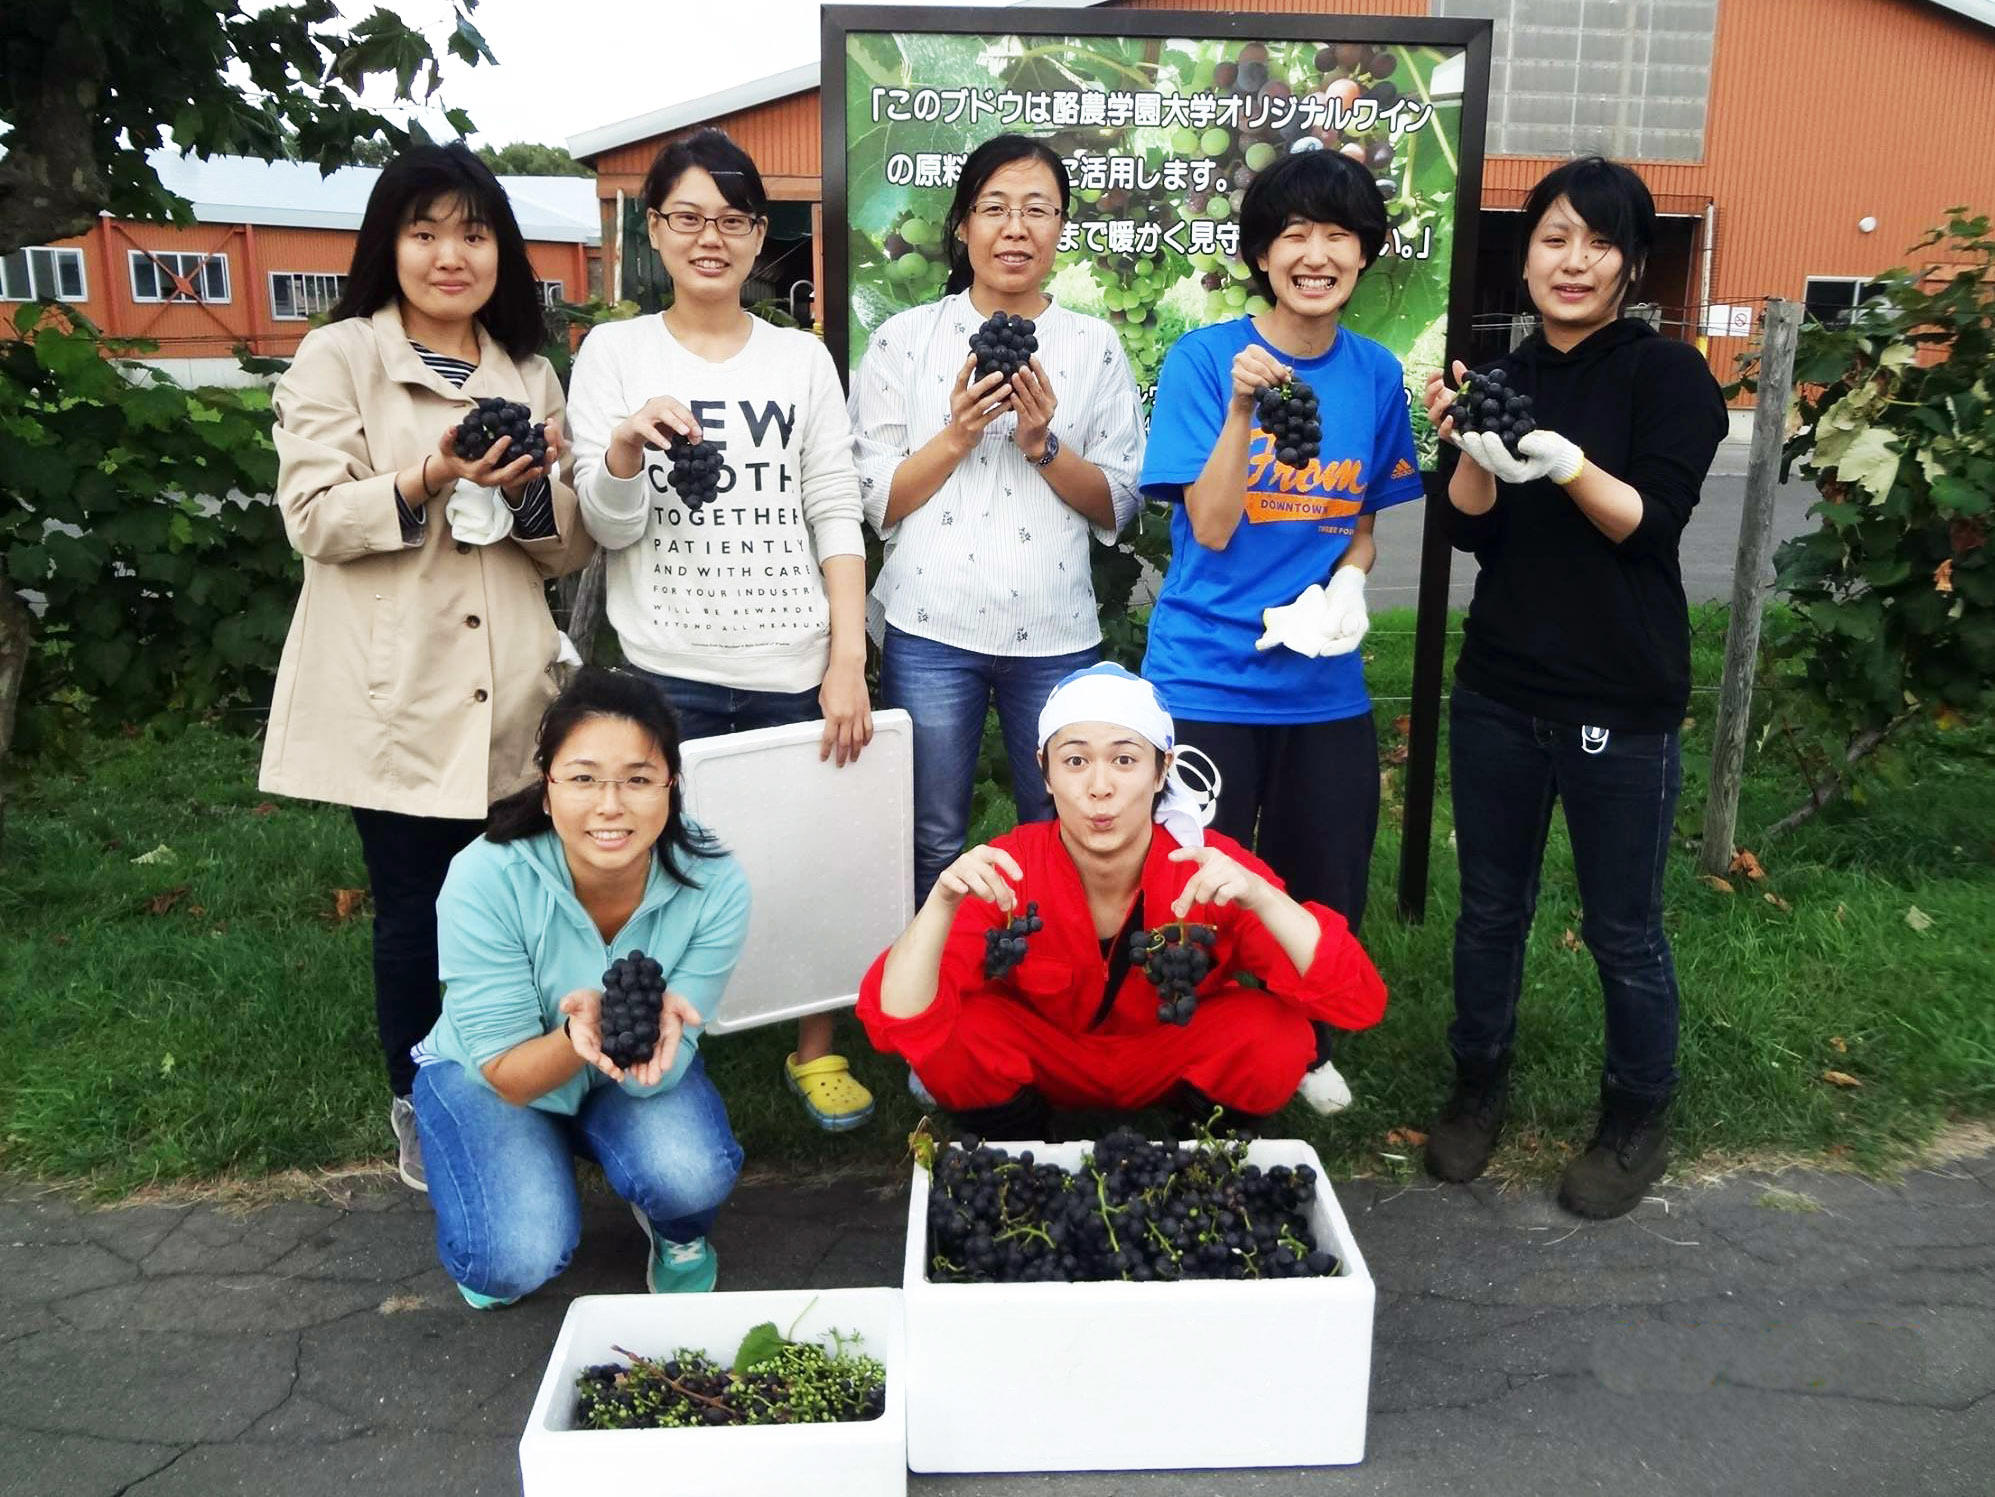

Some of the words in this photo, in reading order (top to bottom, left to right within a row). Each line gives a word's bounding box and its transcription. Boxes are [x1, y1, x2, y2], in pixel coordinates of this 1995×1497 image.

[871, 87, 1433, 133] 「このブドウは酪農学園大学オリジナルワイン
[645, 399, 796, 450] EW
[648, 462, 792, 494] COTH
[1260, 499, 1329, 514] DOWNTOWN
[654, 538, 804, 554] PATIENTLY
[654, 563, 688, 577] AND
[697, 566, 752, 578] WITH
[653, 584, 678, 595] FOR
[686, 587, 727, 598] YOUR
[738, 585, 814, 597] INDUSTR
[654, 603, 691, 615] WILL
[703, 607, 721, 616] BE
